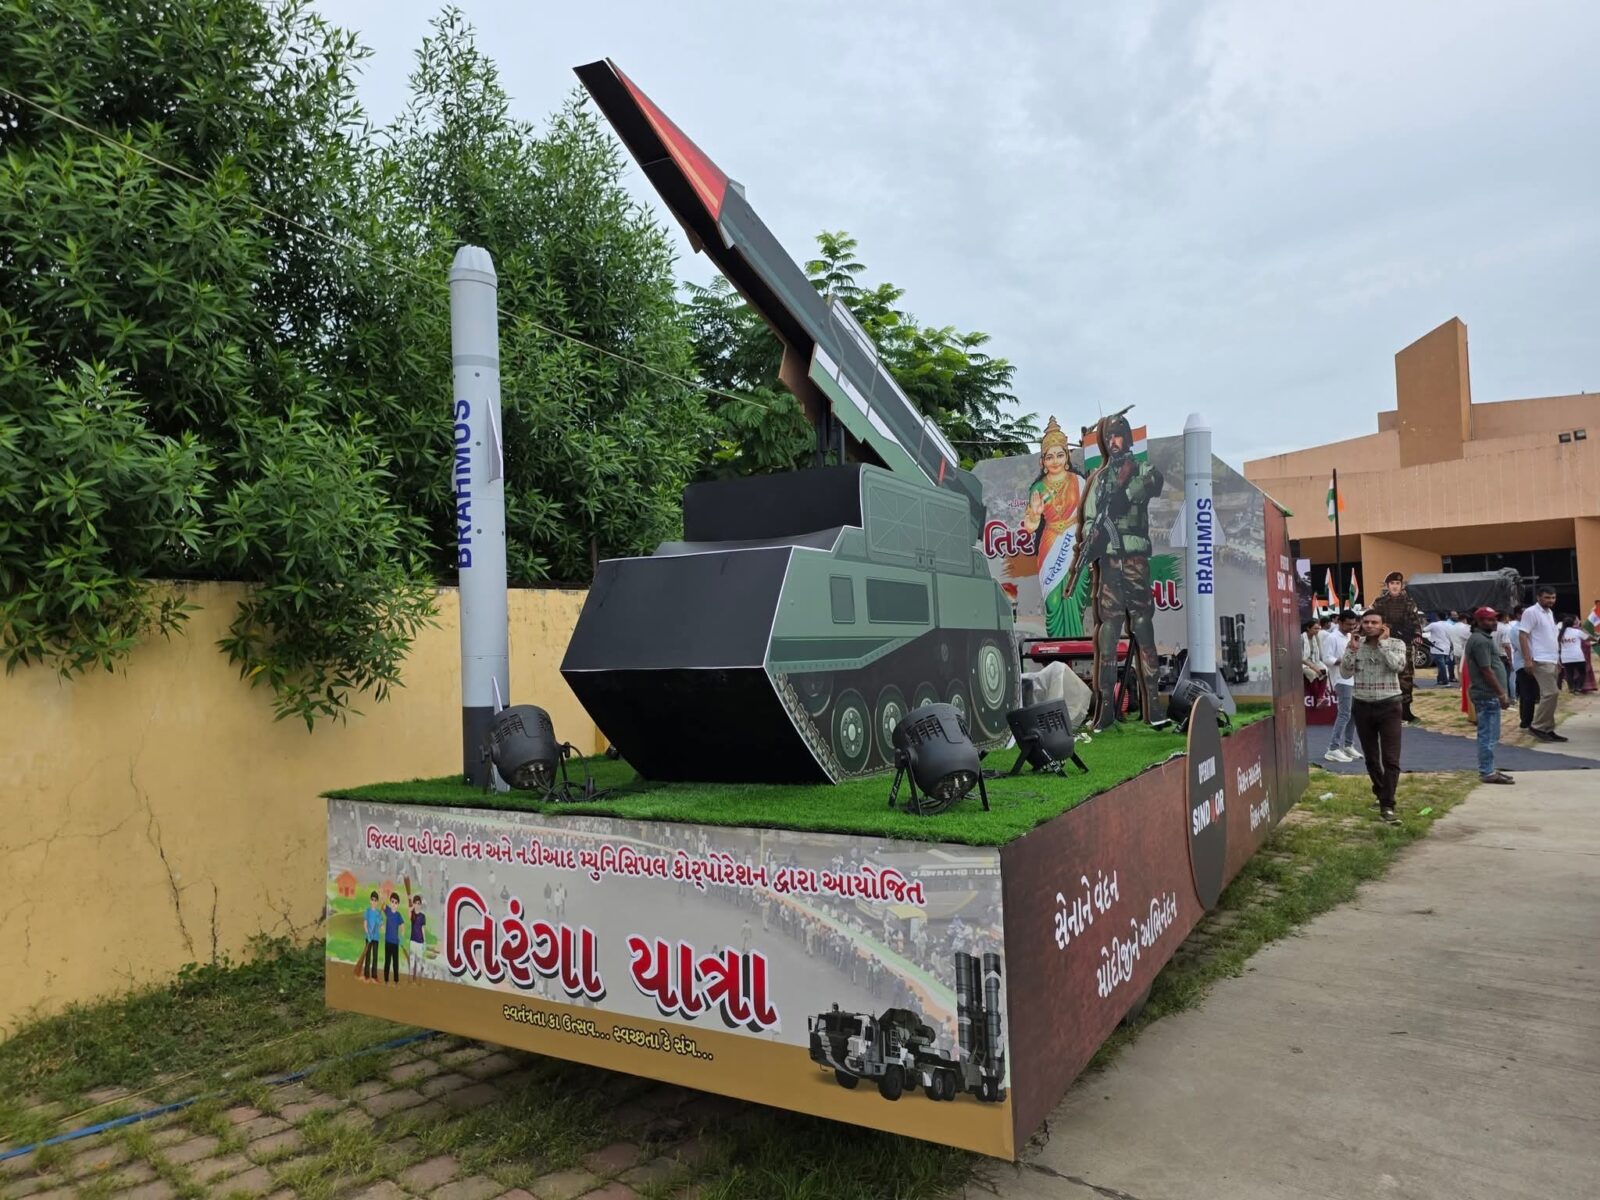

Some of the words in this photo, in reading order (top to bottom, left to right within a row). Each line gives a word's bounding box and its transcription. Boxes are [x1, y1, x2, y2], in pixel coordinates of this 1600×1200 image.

[453, 399, 472, 568] BRAHMOS
[983, 519, 1035, 557] તિરં
[1196, 498, 1213, 594] BRAHMOS
[367, 826, 404, 852] જિલ્લા
[407, 831, 457, 857] વહીવટી
[460, 835, 482, 859] તંત્ર
[486, 837, 513, 863] અને
[516, 840, 577, 869] નડીઆદ
[579, 845, 668, 881] મ્યુનિસિપલ
[774, 868, 818, 894] દ્વારા
[821, 866, 925, 905] આયોજિત
[1054, 875, 1094, 950] સેનાને
[1094, 870, 1120, 915] વંદન
[1096, 918, 1140, 998] મોદીજીને
[1140, 892, 1178, 947] અભિનંદન
[445, 885, 605, 995] તિરંગા
[627, 935, 778, 1028] યાત્રા
[503, 1005, 546, 1026] સ્વતંત્રતા
[548, 1014, 561, 1029] કા
[613, 1026, 660, 1049] સ્વચ્છતા
[660, 1028, 671, 1051] કે
